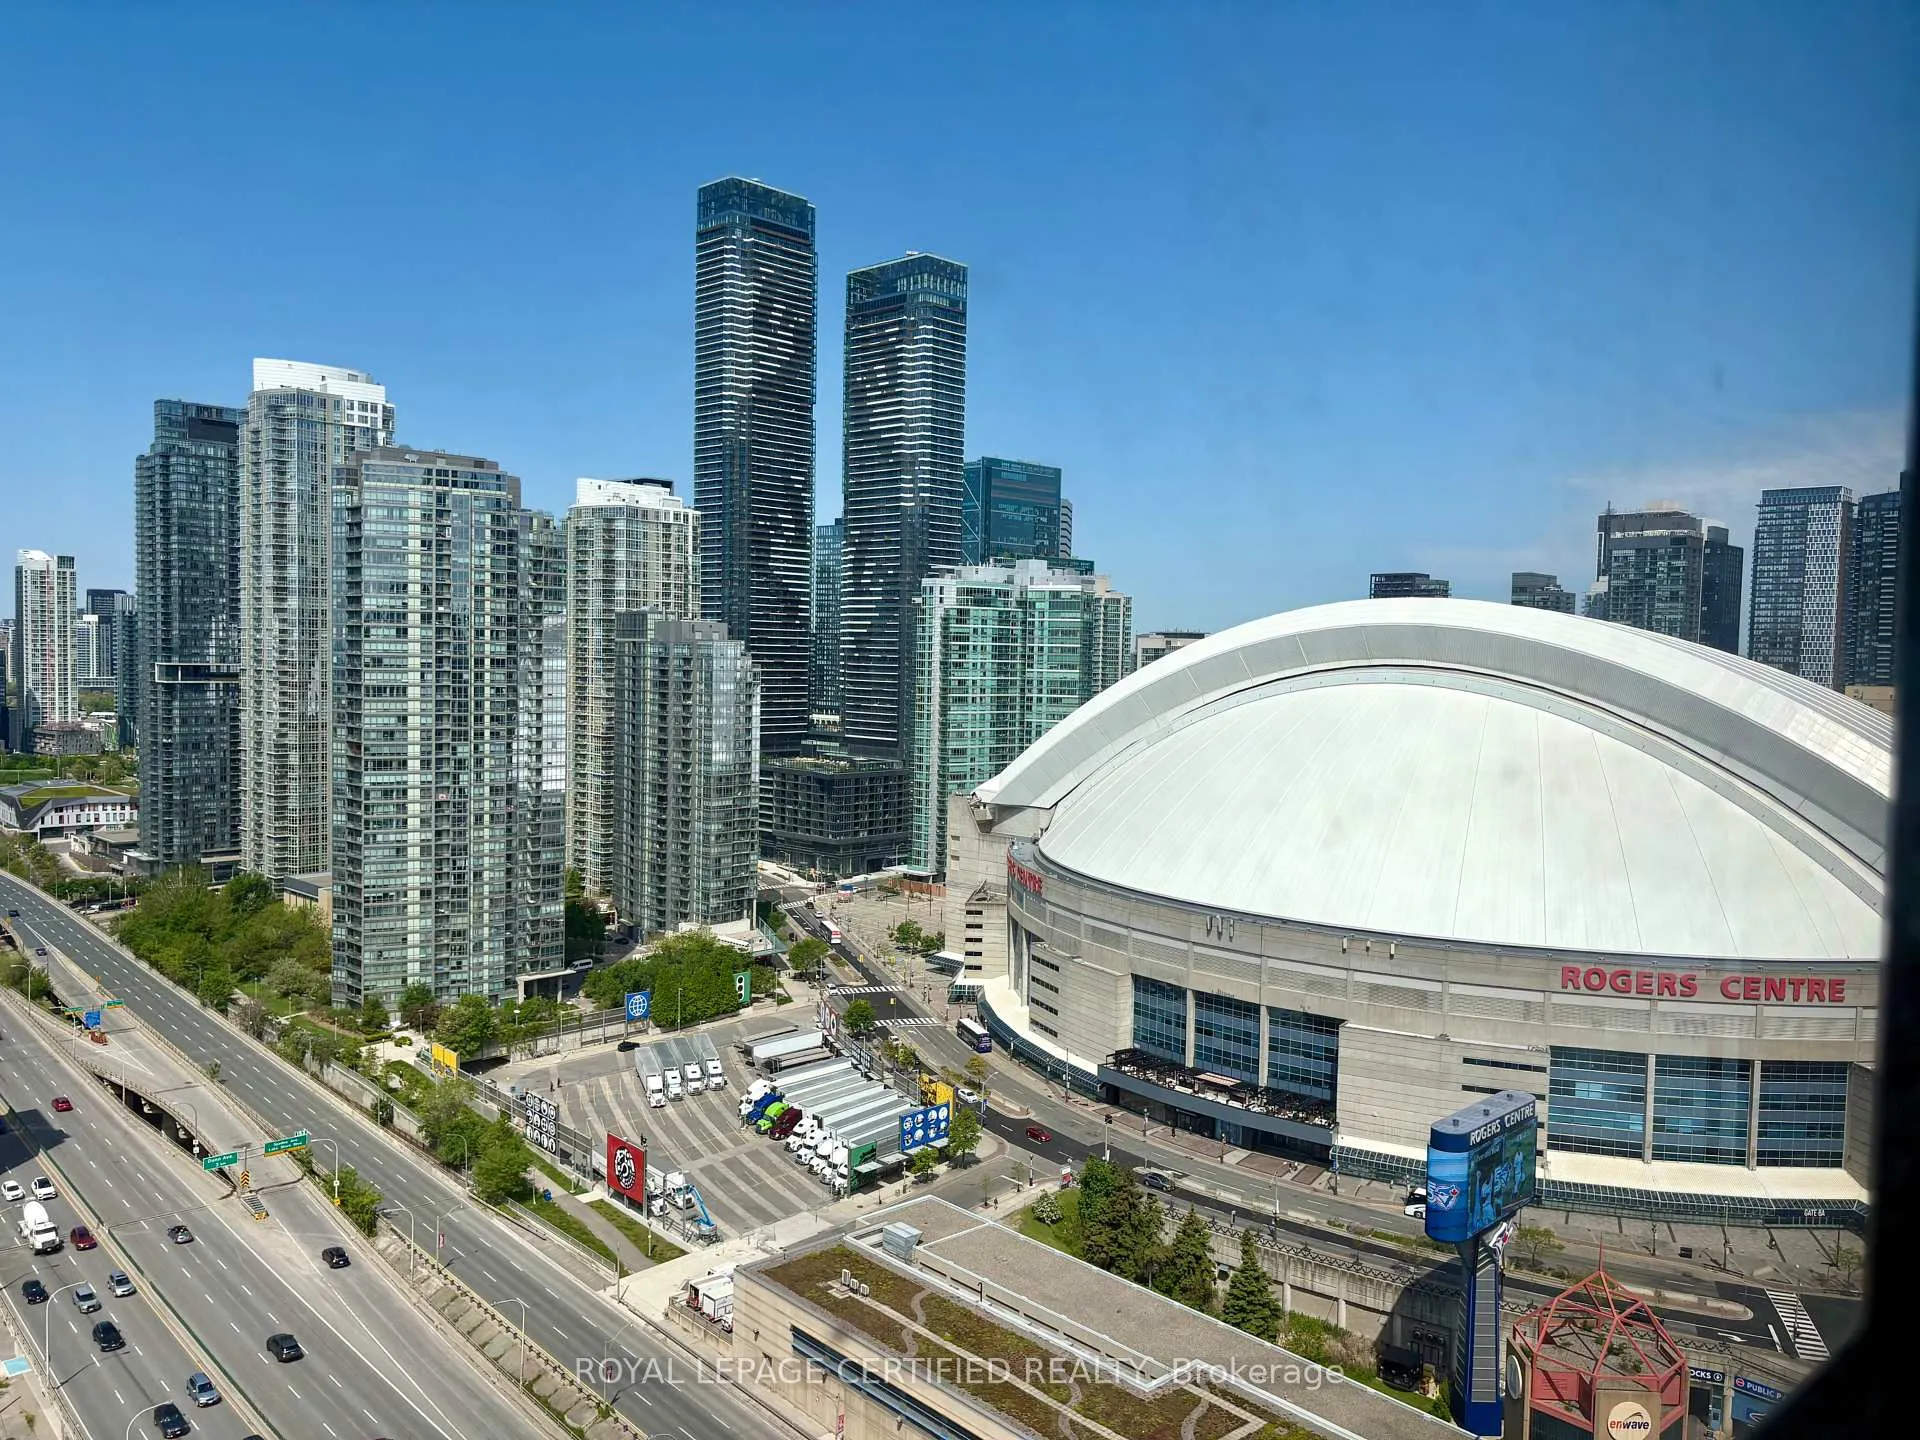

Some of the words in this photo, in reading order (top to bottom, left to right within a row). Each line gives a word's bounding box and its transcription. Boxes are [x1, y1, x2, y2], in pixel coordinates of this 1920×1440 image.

[1561, 966, 1698, 997] ROGERS
[1720, 976, 1846, 1002] CENTRE
[1470, 1119, 1501, 1146] ROGERS
[1504, 1103, 1534, 1128] CENTRE
[1804, 1209, 1817, 1217] GATE
[1690, 1369, 1712, 1379] OCKS
[1746, 1382, 1775, 1397] PUBLIC
[1609, 1420, 1650, 1430] enwave
